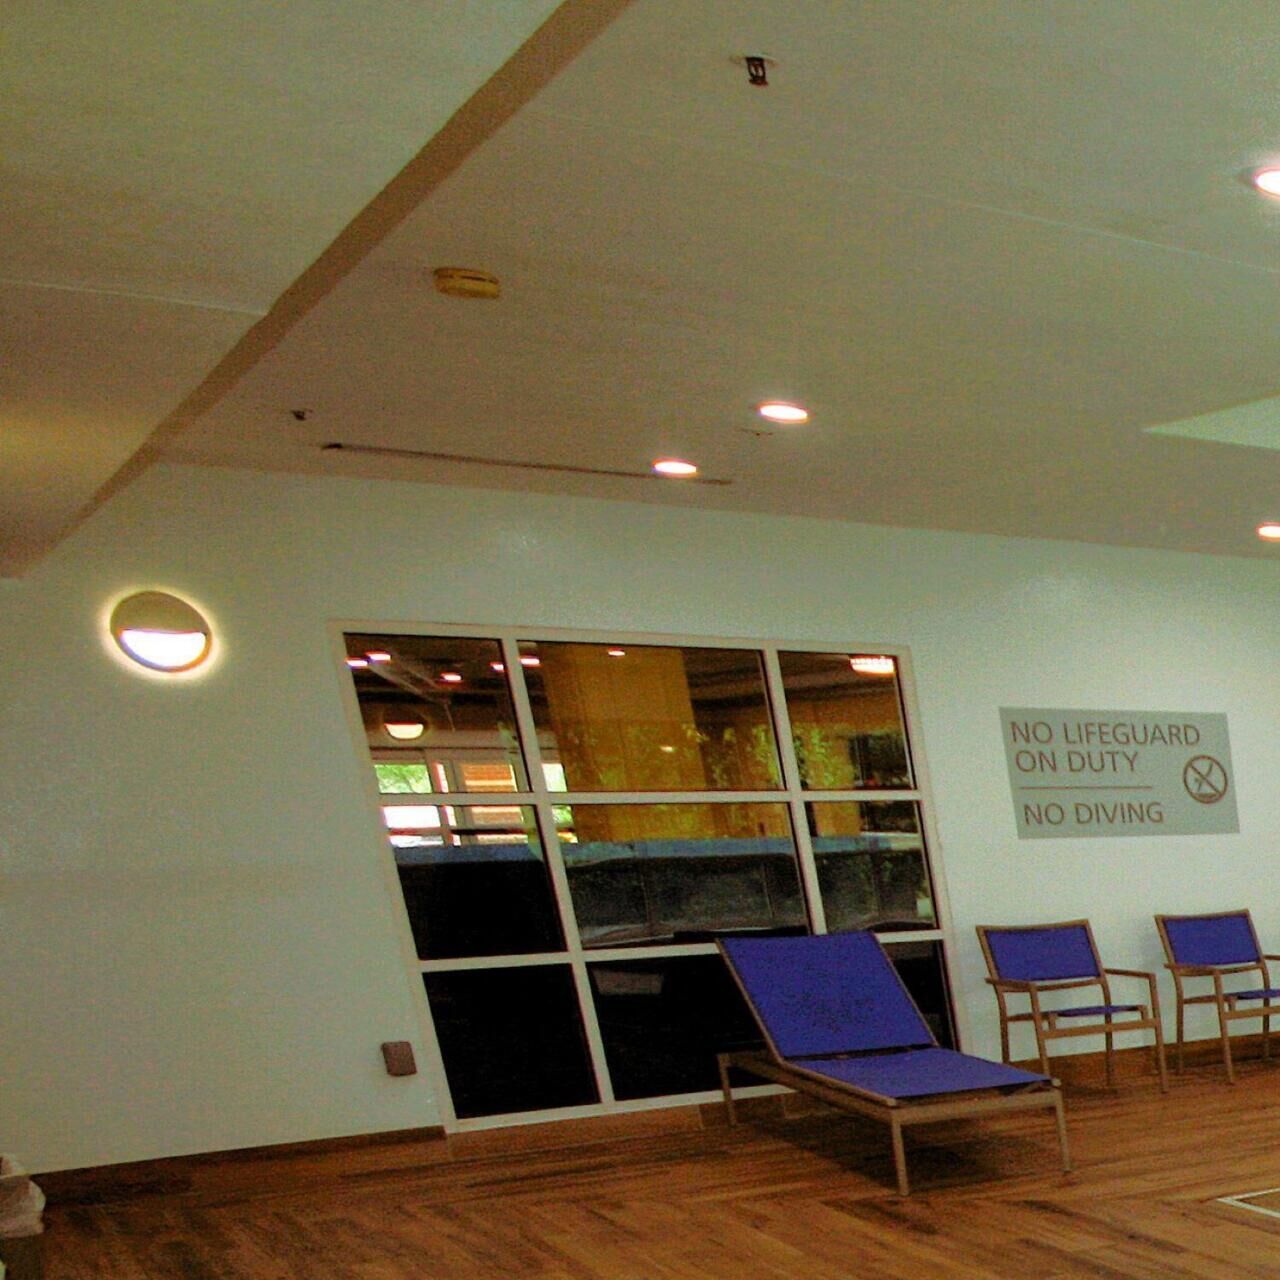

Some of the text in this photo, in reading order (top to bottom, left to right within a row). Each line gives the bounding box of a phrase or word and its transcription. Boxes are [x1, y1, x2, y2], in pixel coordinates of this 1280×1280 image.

[1010, 720, 1200, 745] NO LIFEGUARD
[1015, 751, 1139, 773] ON DUTY
[1024, 802, 1164, 825] NO DIVING
